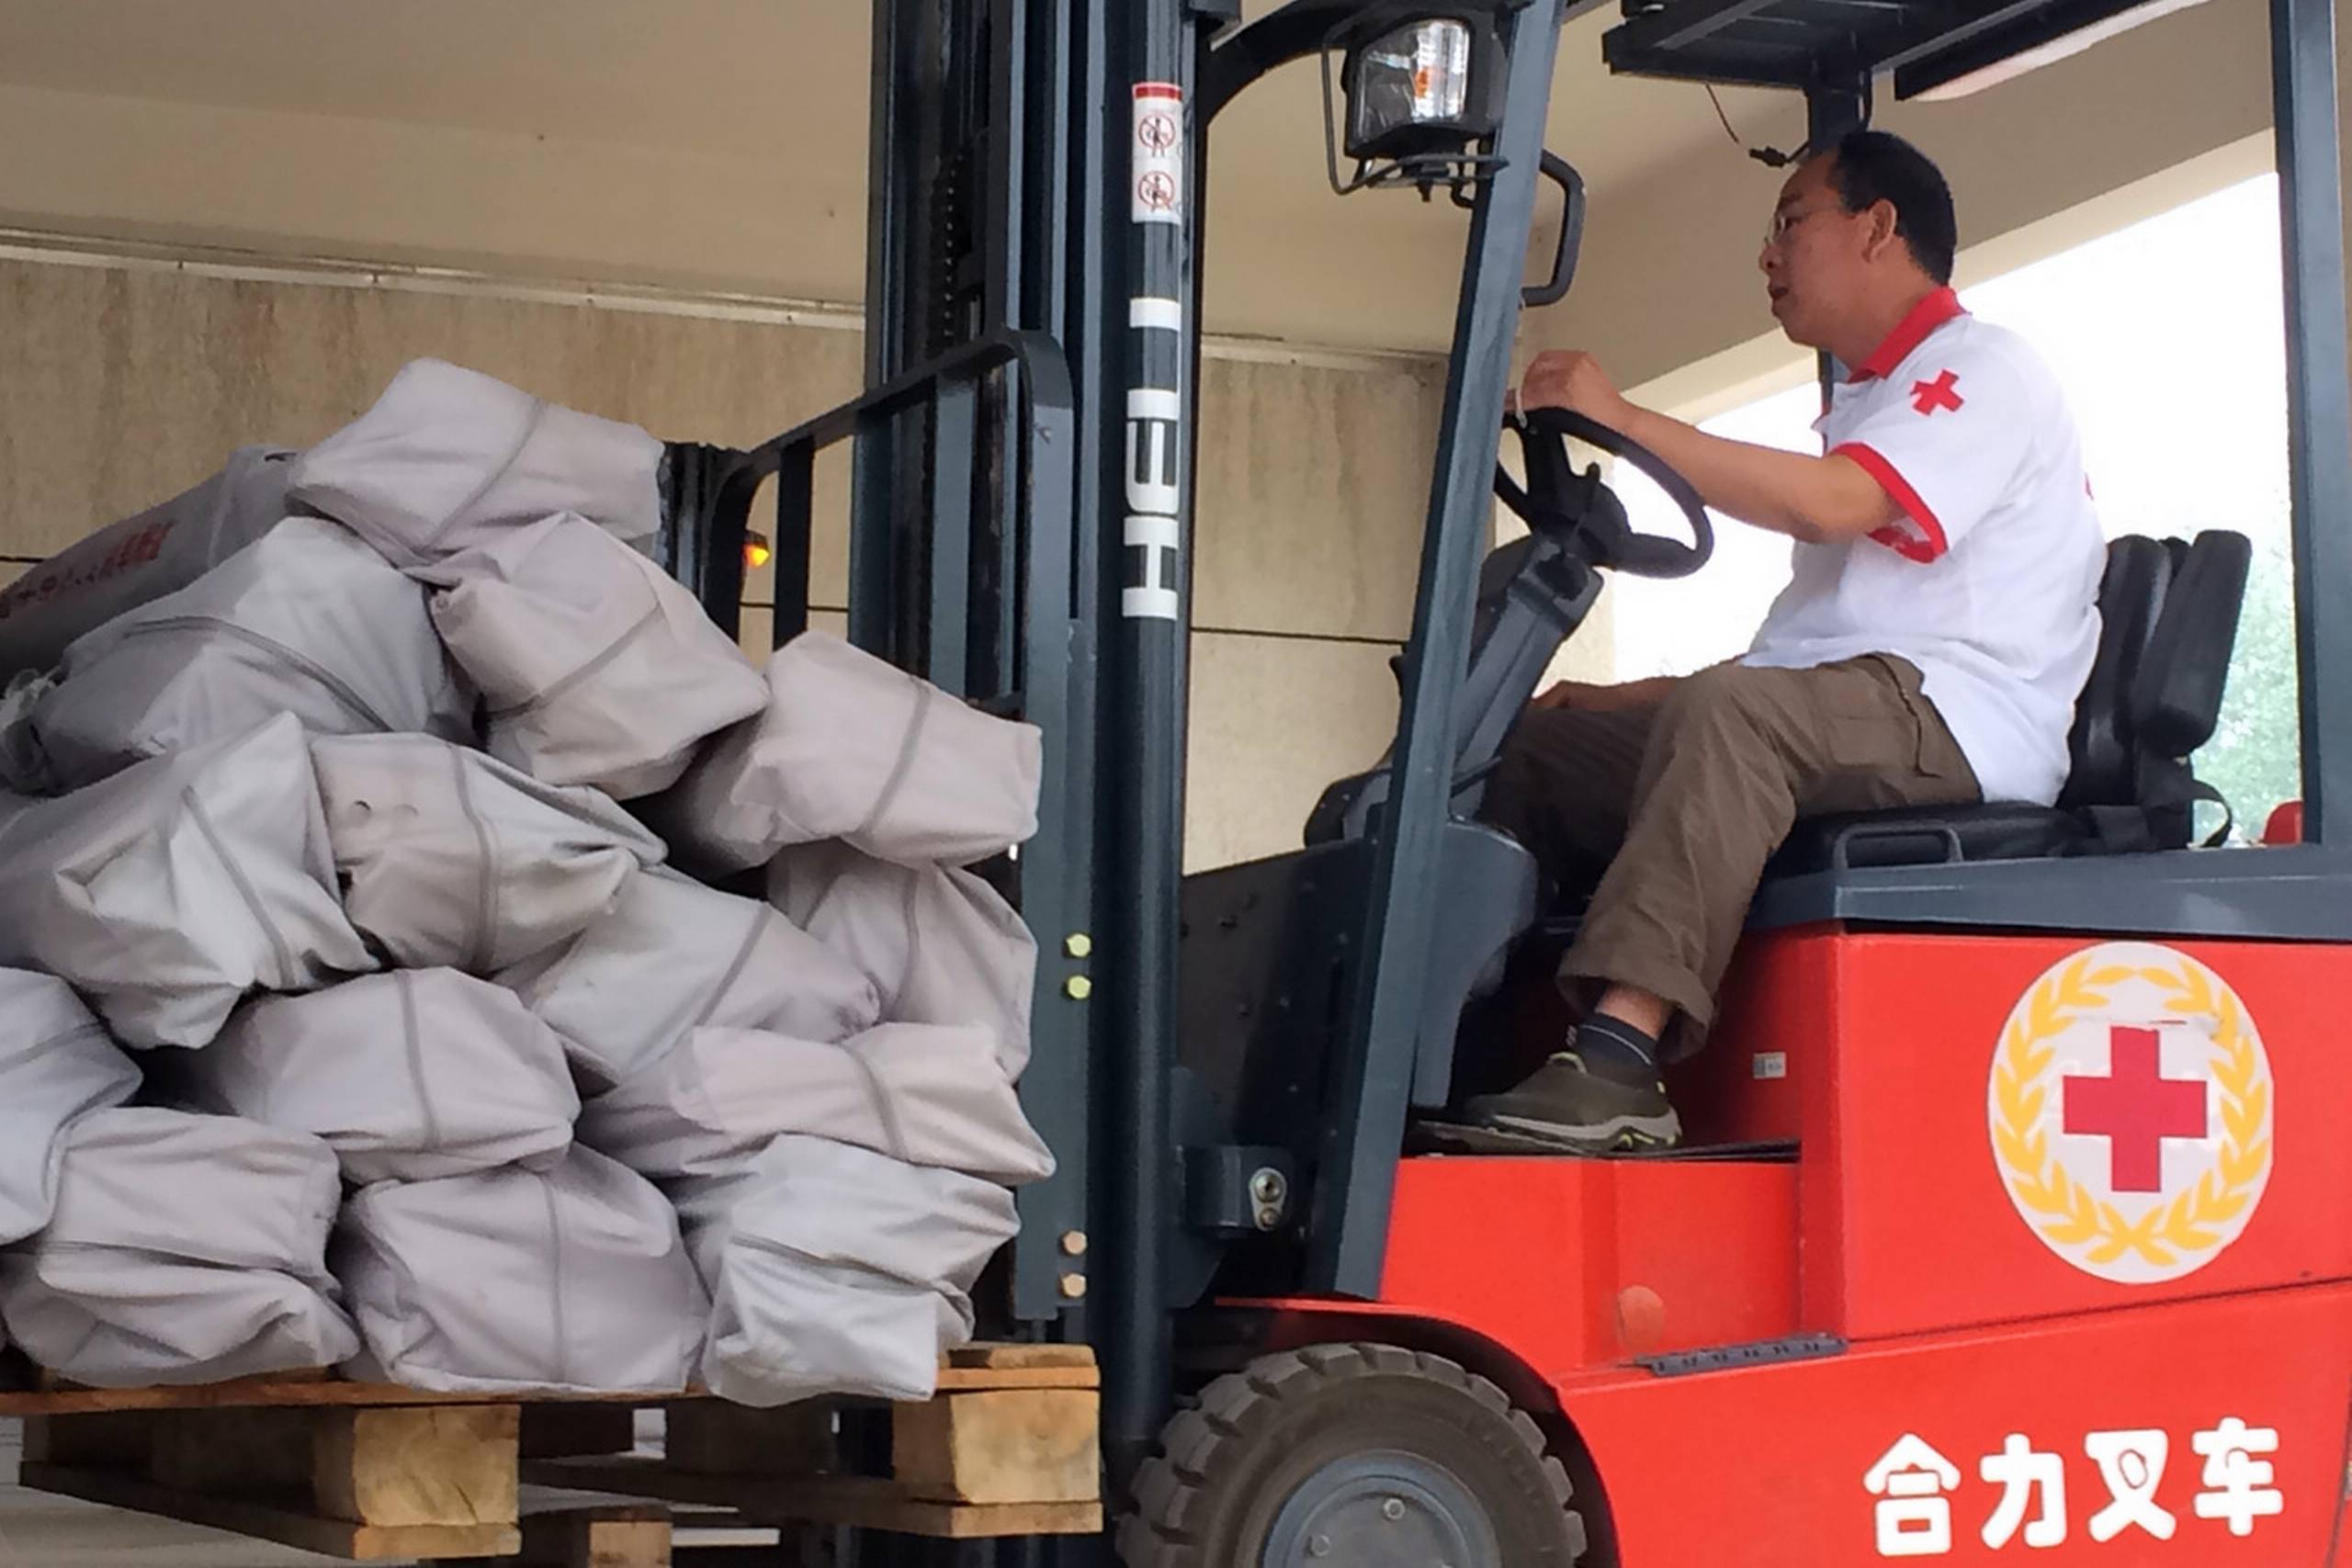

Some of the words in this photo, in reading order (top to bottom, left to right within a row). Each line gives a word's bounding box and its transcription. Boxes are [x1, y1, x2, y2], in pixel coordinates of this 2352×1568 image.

[1122, 298, 1182, 620] HELI
[1863, 1416, 2283, 1556] 合力叉车
